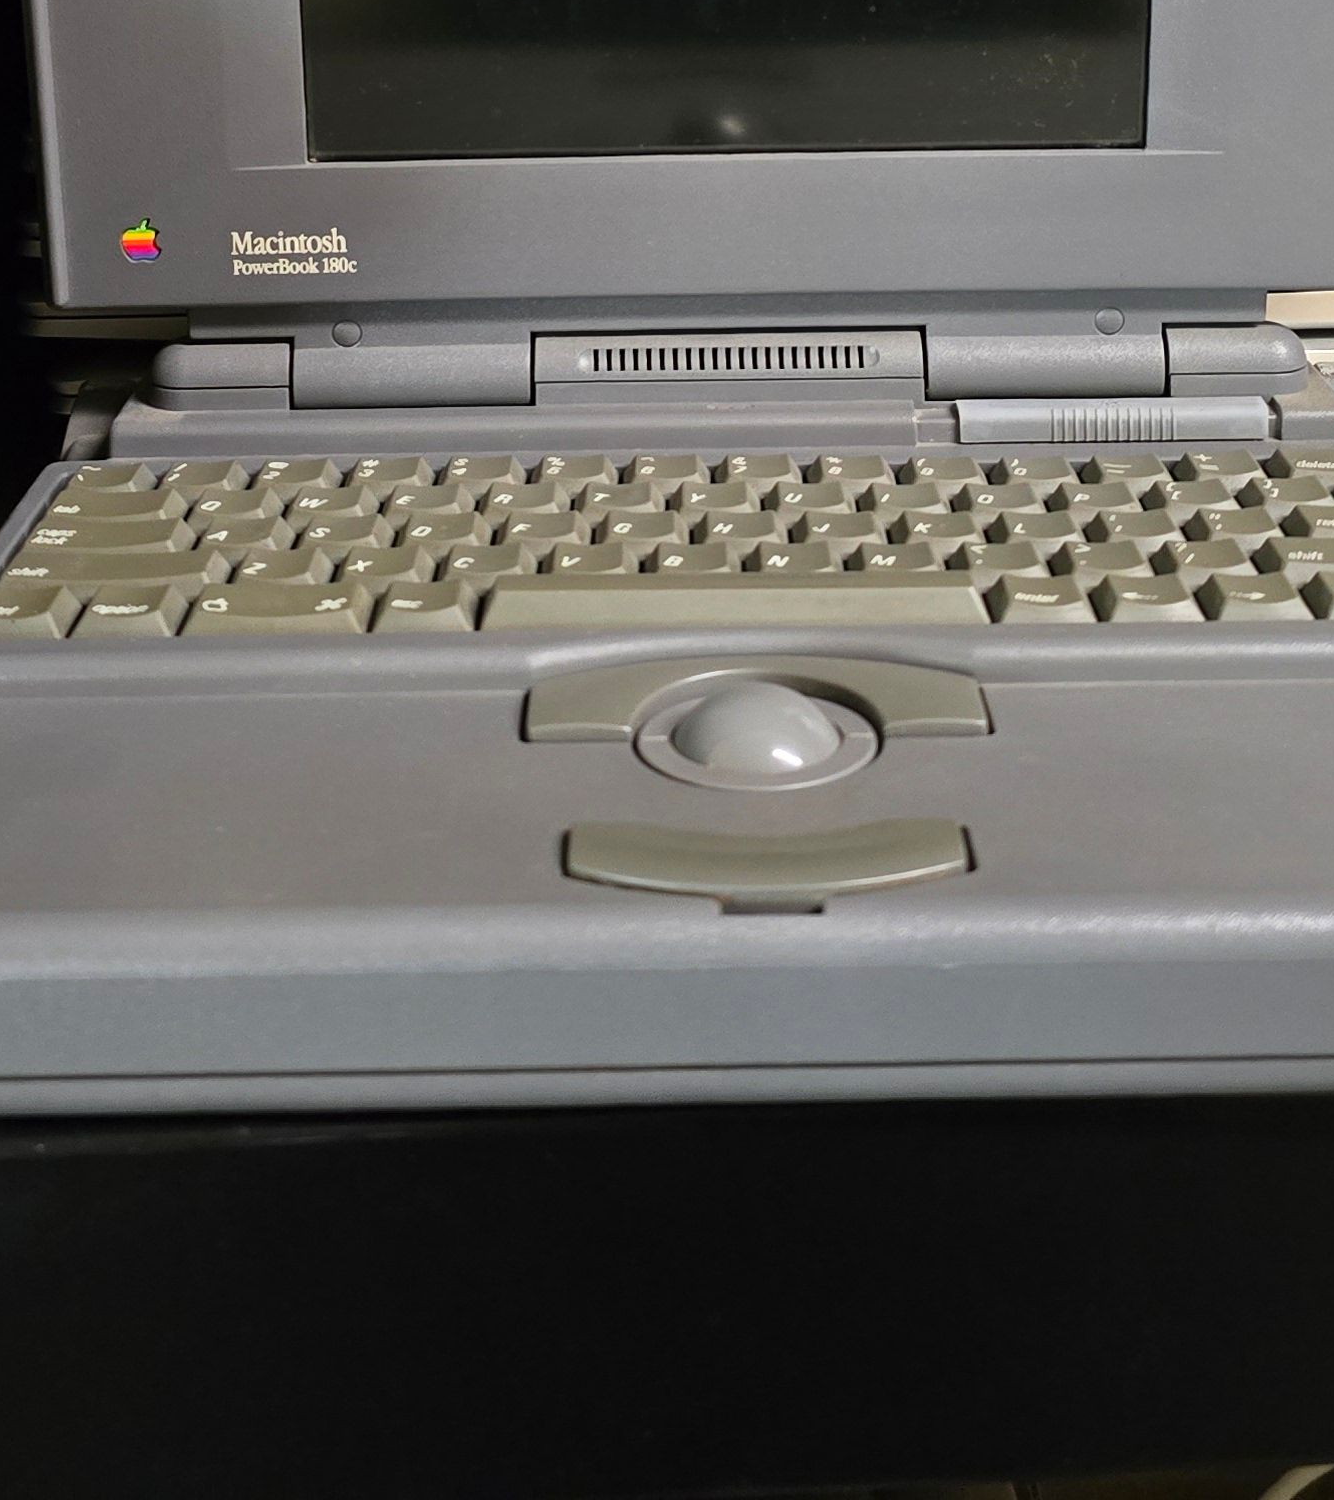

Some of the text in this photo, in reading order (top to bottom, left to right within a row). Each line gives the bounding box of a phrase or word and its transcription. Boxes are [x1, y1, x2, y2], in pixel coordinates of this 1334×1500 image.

[231, 228, 347, 256] Macintosh
[233, 257, 357, 276] PowerBook 180c
[299, 498, 329, 508] W
[396, 495, 416, 505] E
[493, 494, 514, 504] R
[593, 492, 611, 502] T
[690, 492, 707, 503] Y
[784, 492, 803, 503] U
[977, 494, 994, 504] O
[1073, 493, 1091, 503] P
[206, 530, 229, 542] A
[309, 527, 331, 539] S
[410, 526, 433, 537] D
[511, 523, 532, 533] F
[713, 522, 734, 534] H
[812, 522, 831, 534] J
[913, 522, 932, 534] K
[1013, 522, 1026, 534] L
[243, 562, 268, 575] Z
[347, 559, 374, 572] X
[453, 557, 475, 569] C
[561, 556, 582, 568] V
[663, 555, 684, 567] B
[767, 555, 790, 567] N
[869, 554, 897, 567] M
